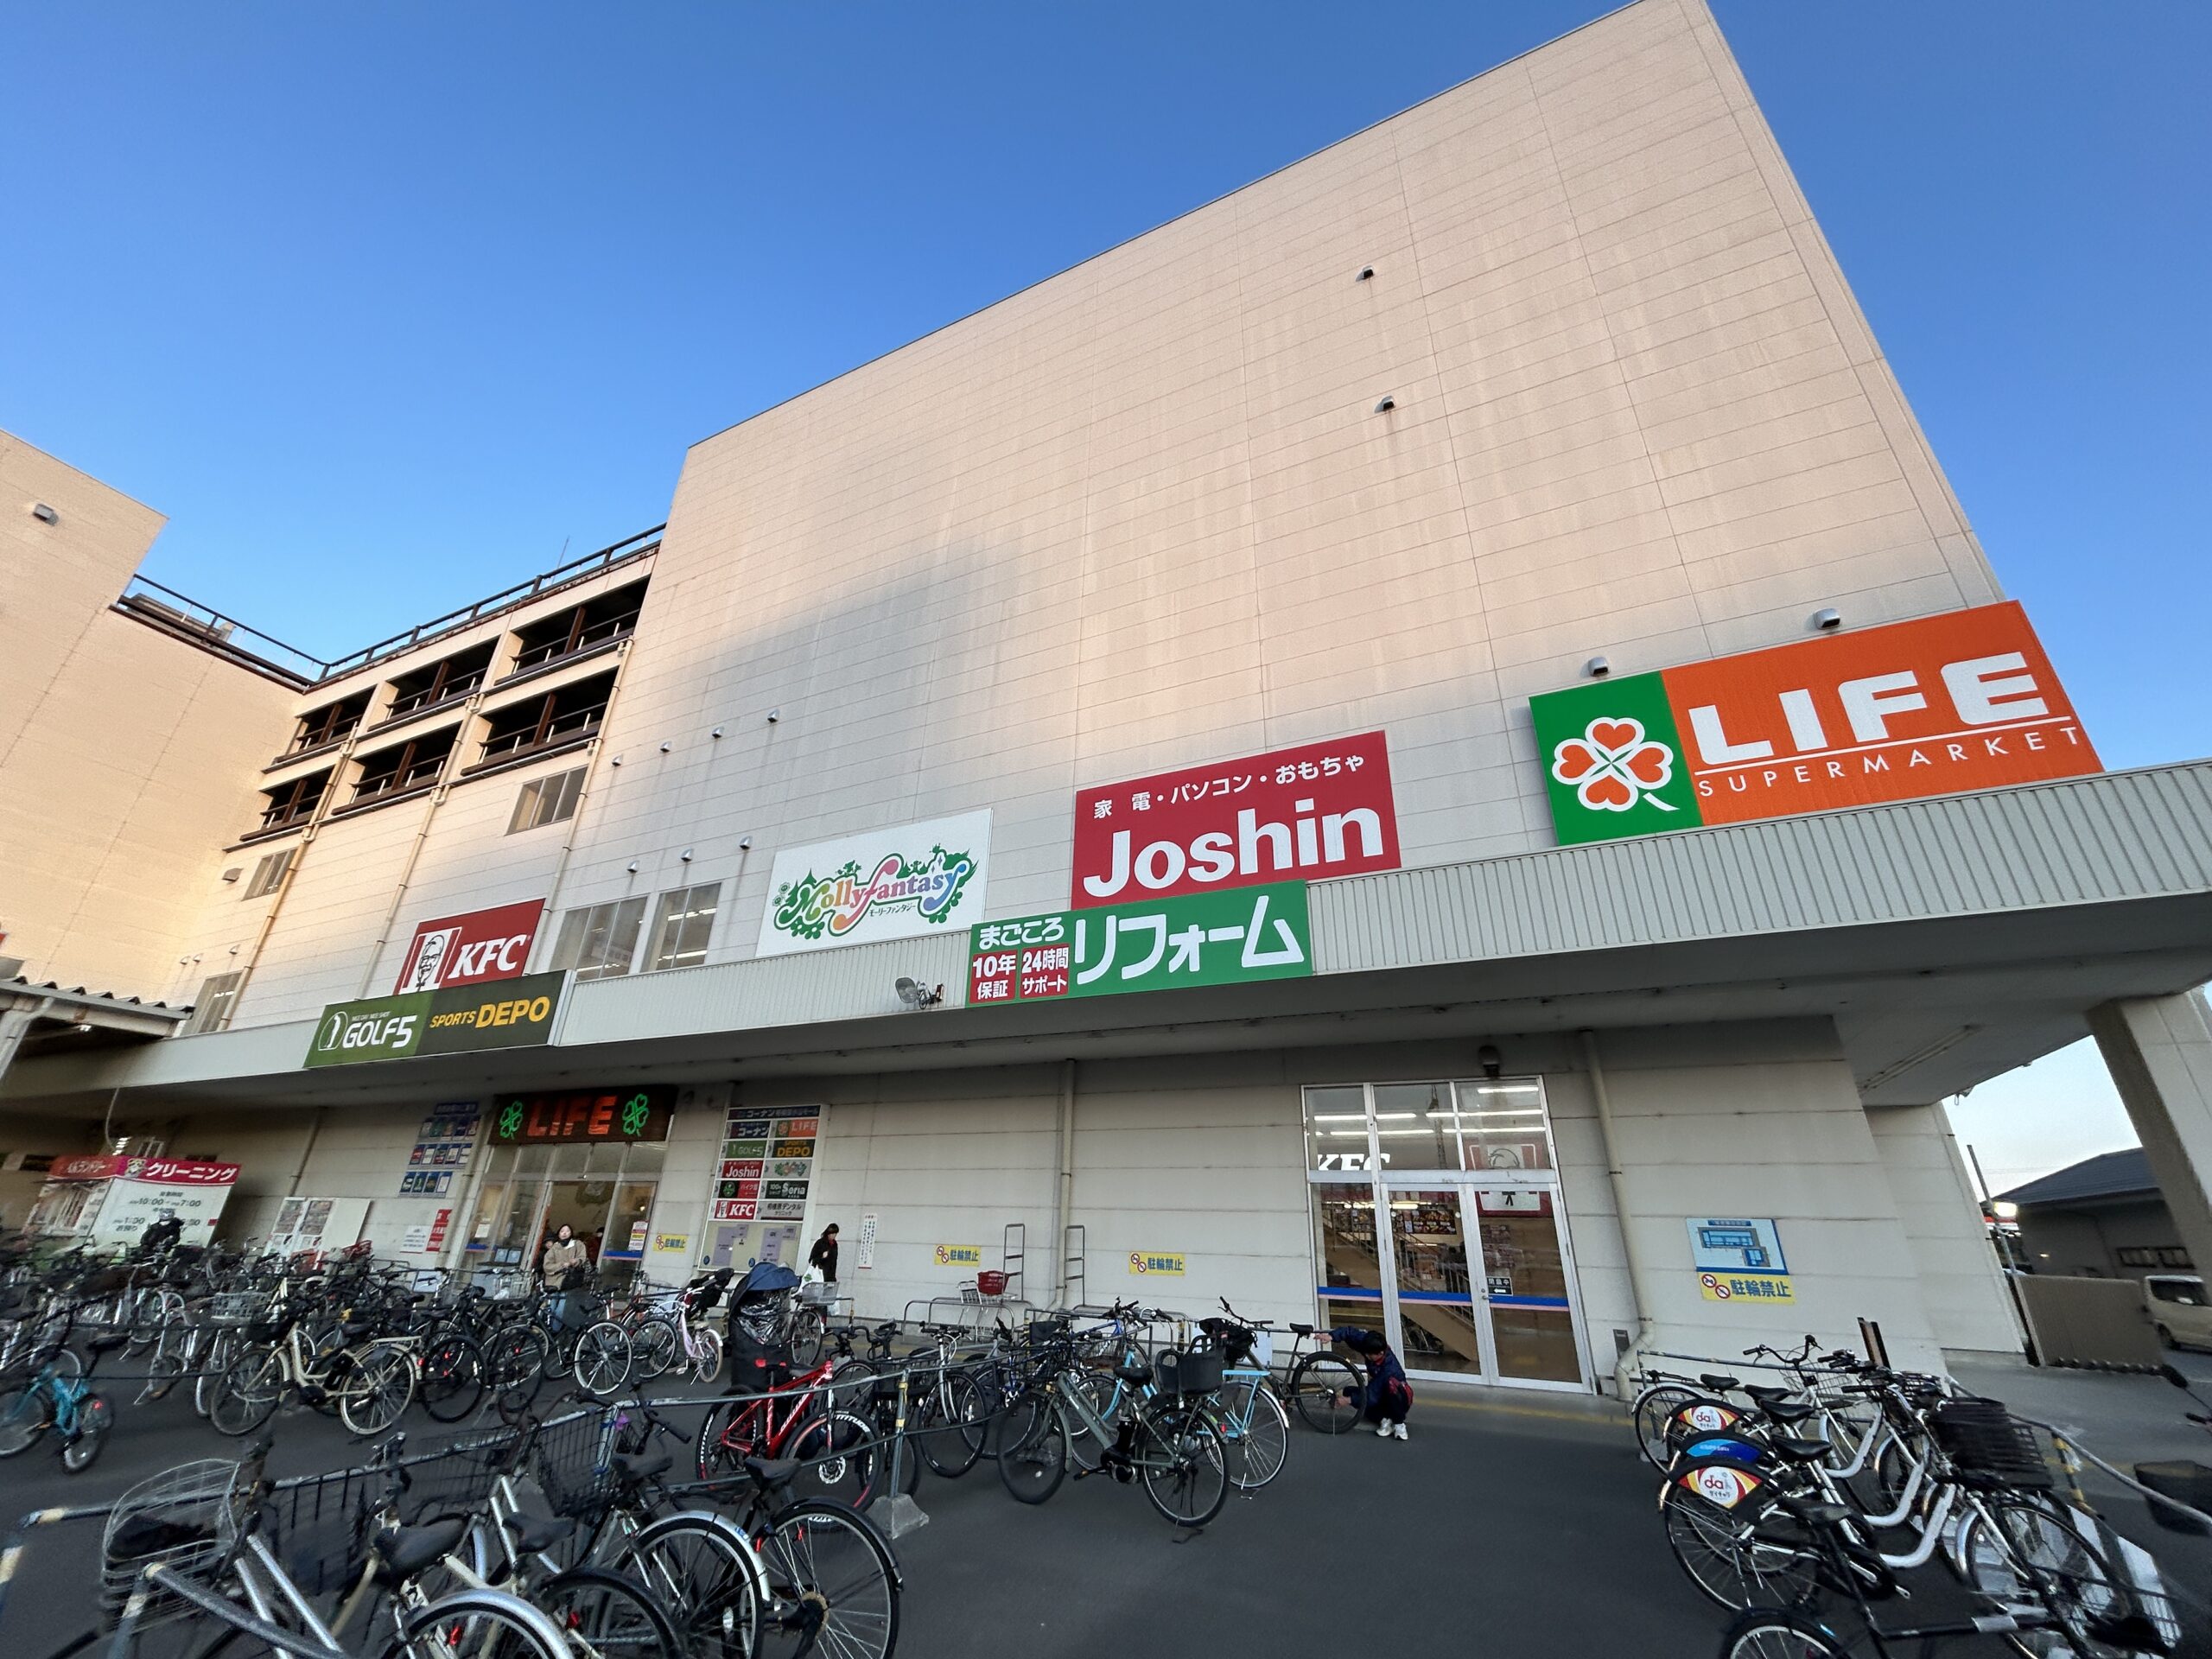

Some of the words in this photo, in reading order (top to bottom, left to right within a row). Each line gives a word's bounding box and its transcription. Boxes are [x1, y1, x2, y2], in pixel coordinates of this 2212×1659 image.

[1688, 652, 2050, 766] LIFE
[1699, 727, 2080, 798] SUPERMARKET
[1084, 798, 1384, 898] Joshin
[869, 903, 916, 917] モーリーファンタジー
[978, 917, 1065, 950] まごころ
[1073, 895, 1304, 985] リフォーム
[447, 934, 527, 979] KFC
[973, 953, 1016, 978] 10年
[1021, 947, 1069, 974] 24時間
[976, 981, 1008, 1001] 保証
[1022, 976, 1067, 996] サポート
[429, 1010, 477, 1029] SPORTS
[475, 995, 550, 1029] DEPO
[342, 1015, 416, 1049] GOLF5
[527, 1096, 617, 1136] LIFE
[791, 1121, 817, 1131] LIFE
[738, 1127, 769, 1136] コーナン
[777, 1147, 810, 1156] DEPO
[146, 1162, 237, 1181] クリーニング
[726, 1166, 760, 1177] Joshin
[729, 1204, 754, 1216] KFC
[950, 1249, 978, 1262] 駐輪禁止
[1147, 1257, 1183, 1271] 駐輪禁止
[1730, 1279, 1791, 1297] 駐輪禁止
[834, 1414, 871, 1433] TTITUDE
